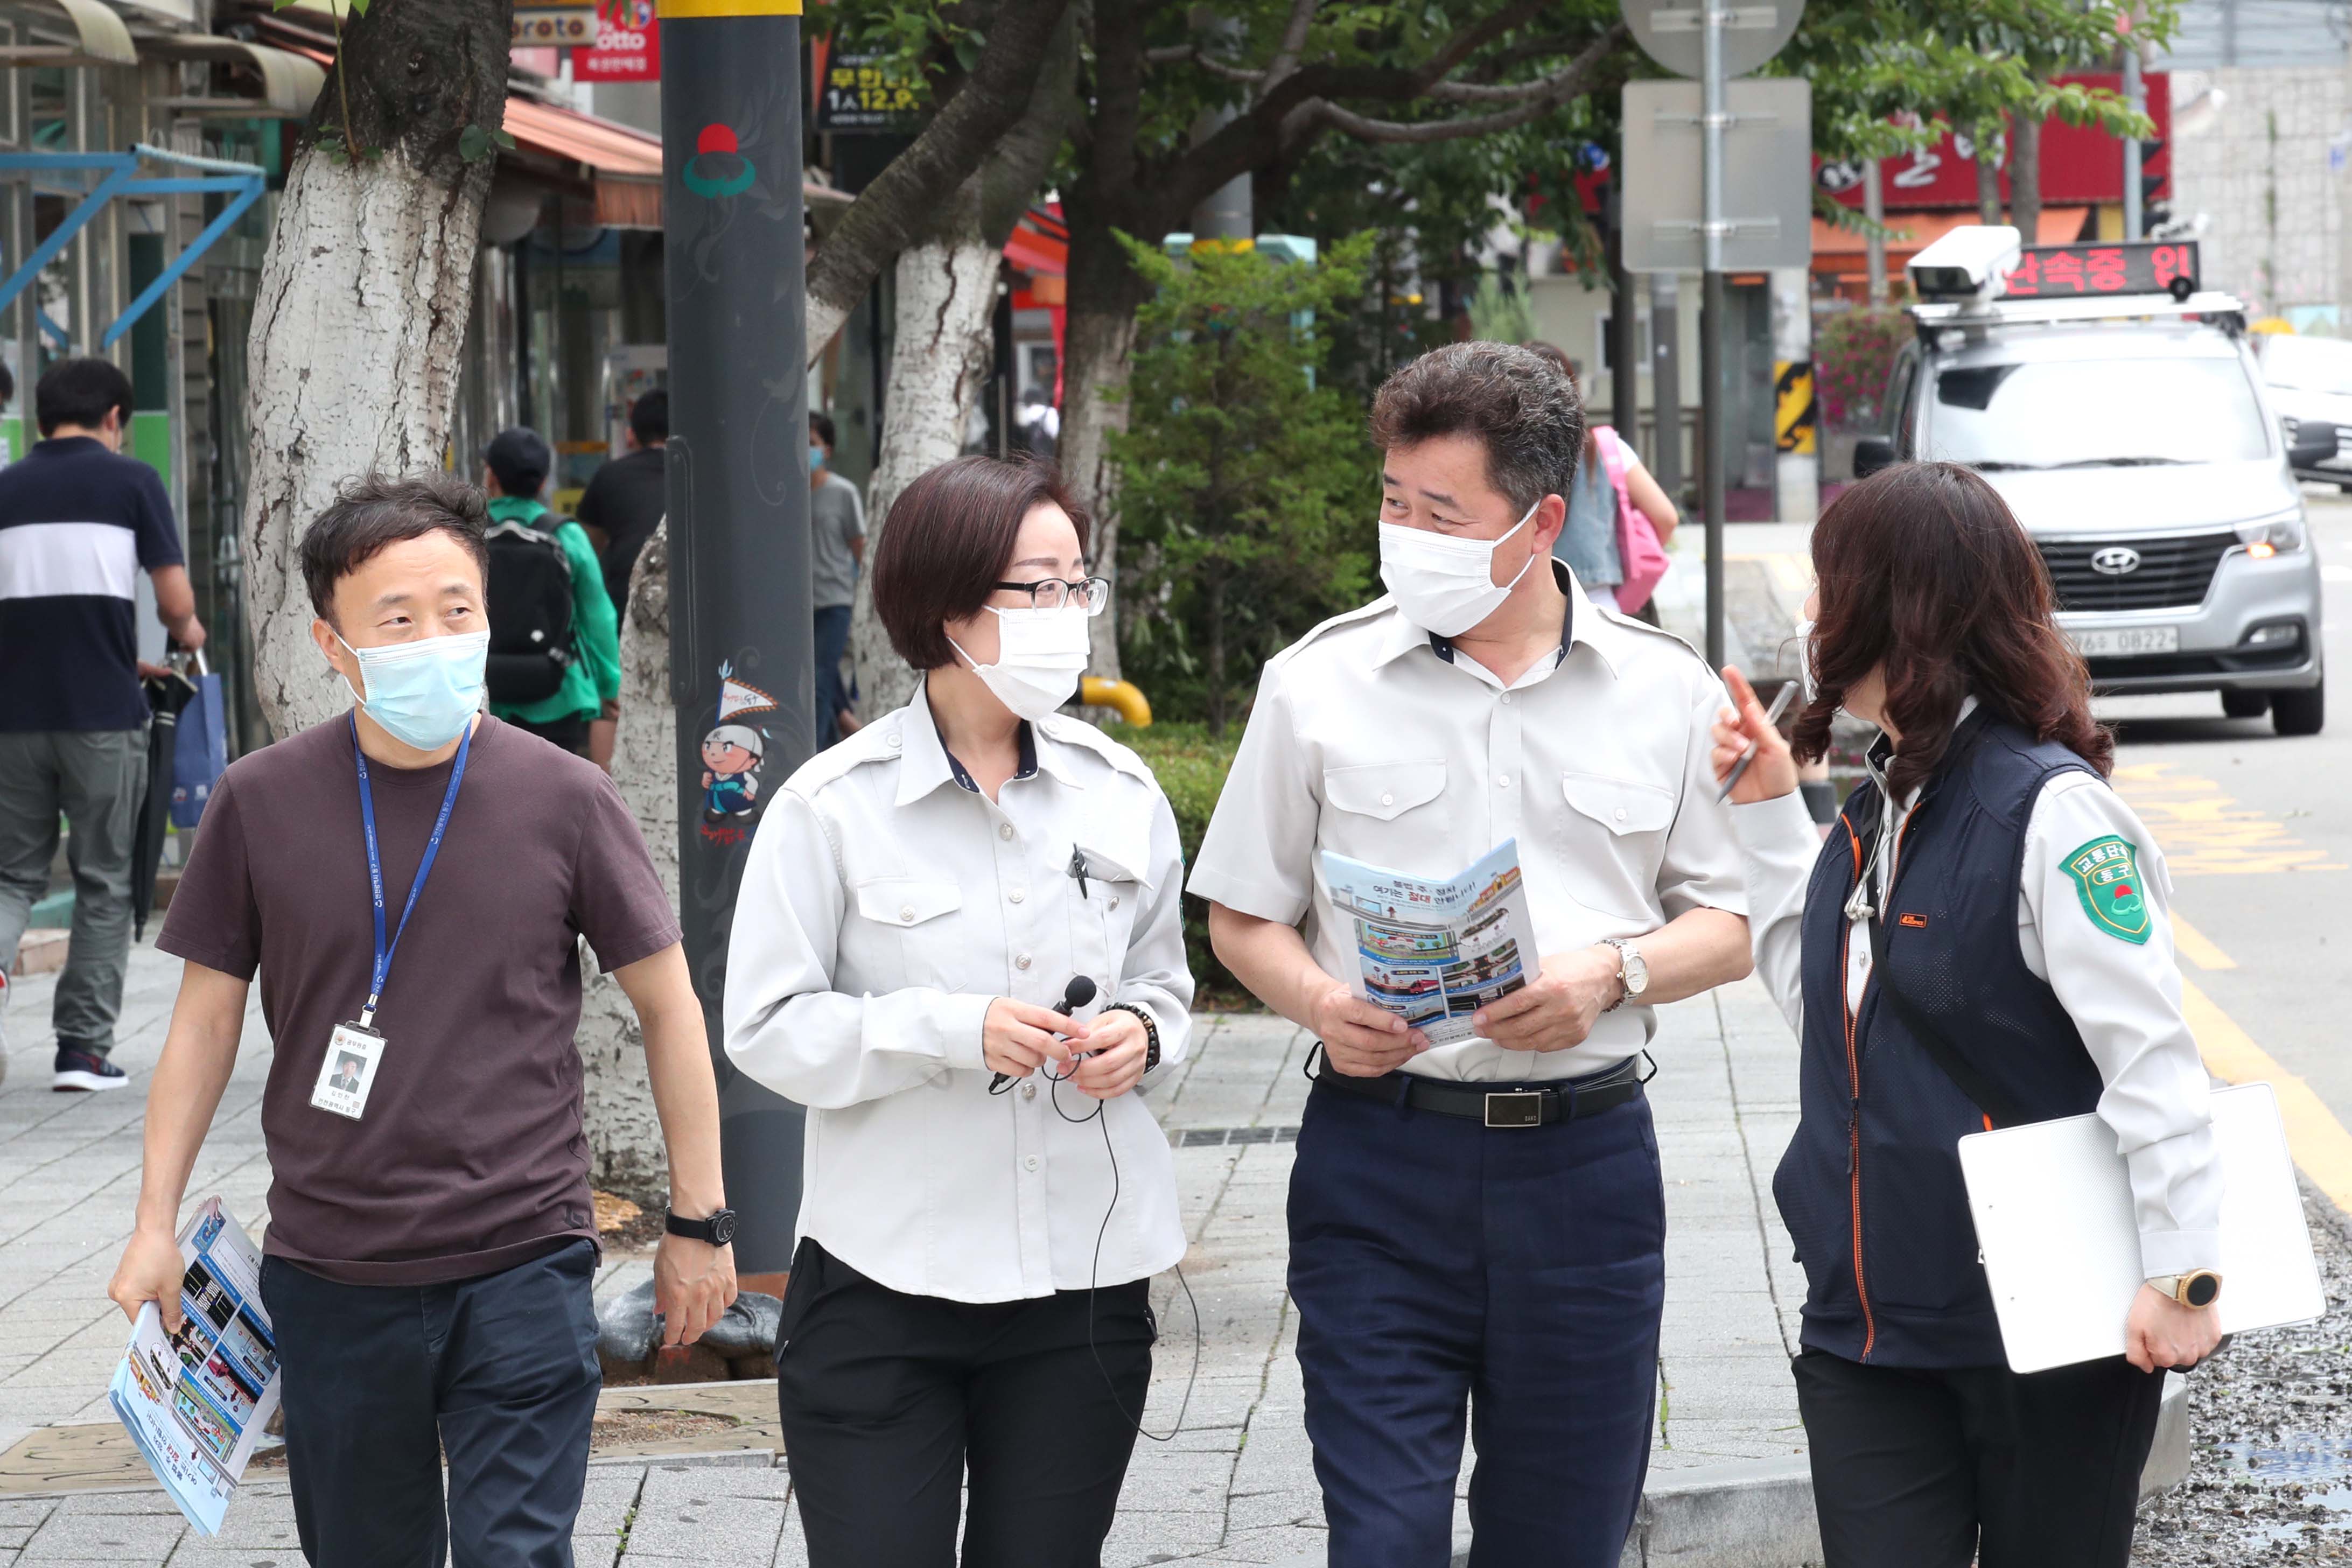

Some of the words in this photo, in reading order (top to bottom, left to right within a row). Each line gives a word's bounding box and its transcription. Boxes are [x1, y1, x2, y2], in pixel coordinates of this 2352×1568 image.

[597, 31, 646, 50] otto
[1374, 885, 1403, 898] 여기는
[1409, 891, 1431, 903] 절대
[1394, 880, 1413, 890] 불법
[166, 1443, 180, 1463] 절대
[180, 1461, 197, 1485] 여기는
